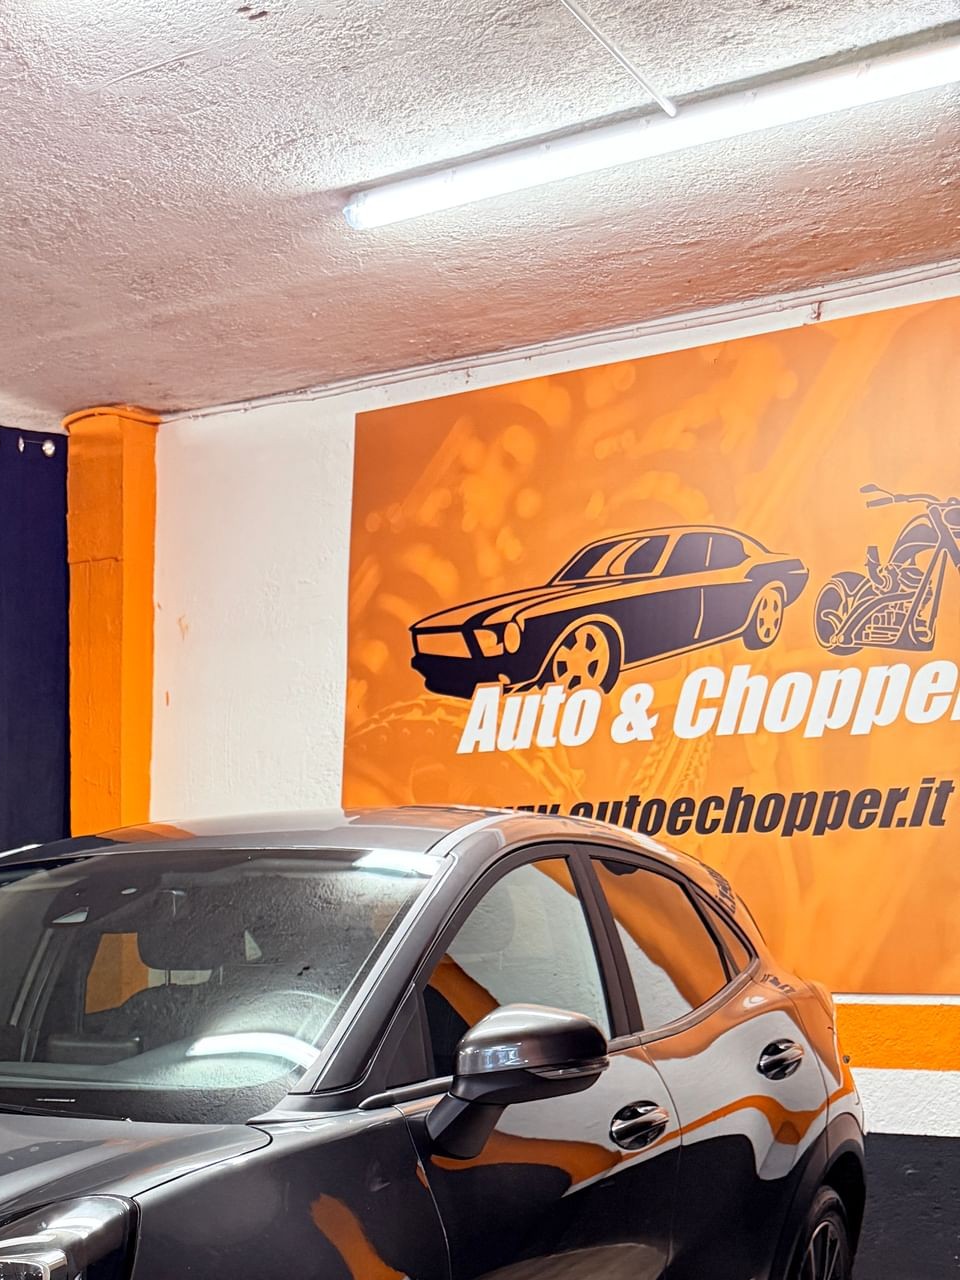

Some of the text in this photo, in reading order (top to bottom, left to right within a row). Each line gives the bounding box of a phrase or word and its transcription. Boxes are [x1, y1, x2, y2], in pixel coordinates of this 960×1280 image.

[457, 660, 960, 754] Auto & Choppe
